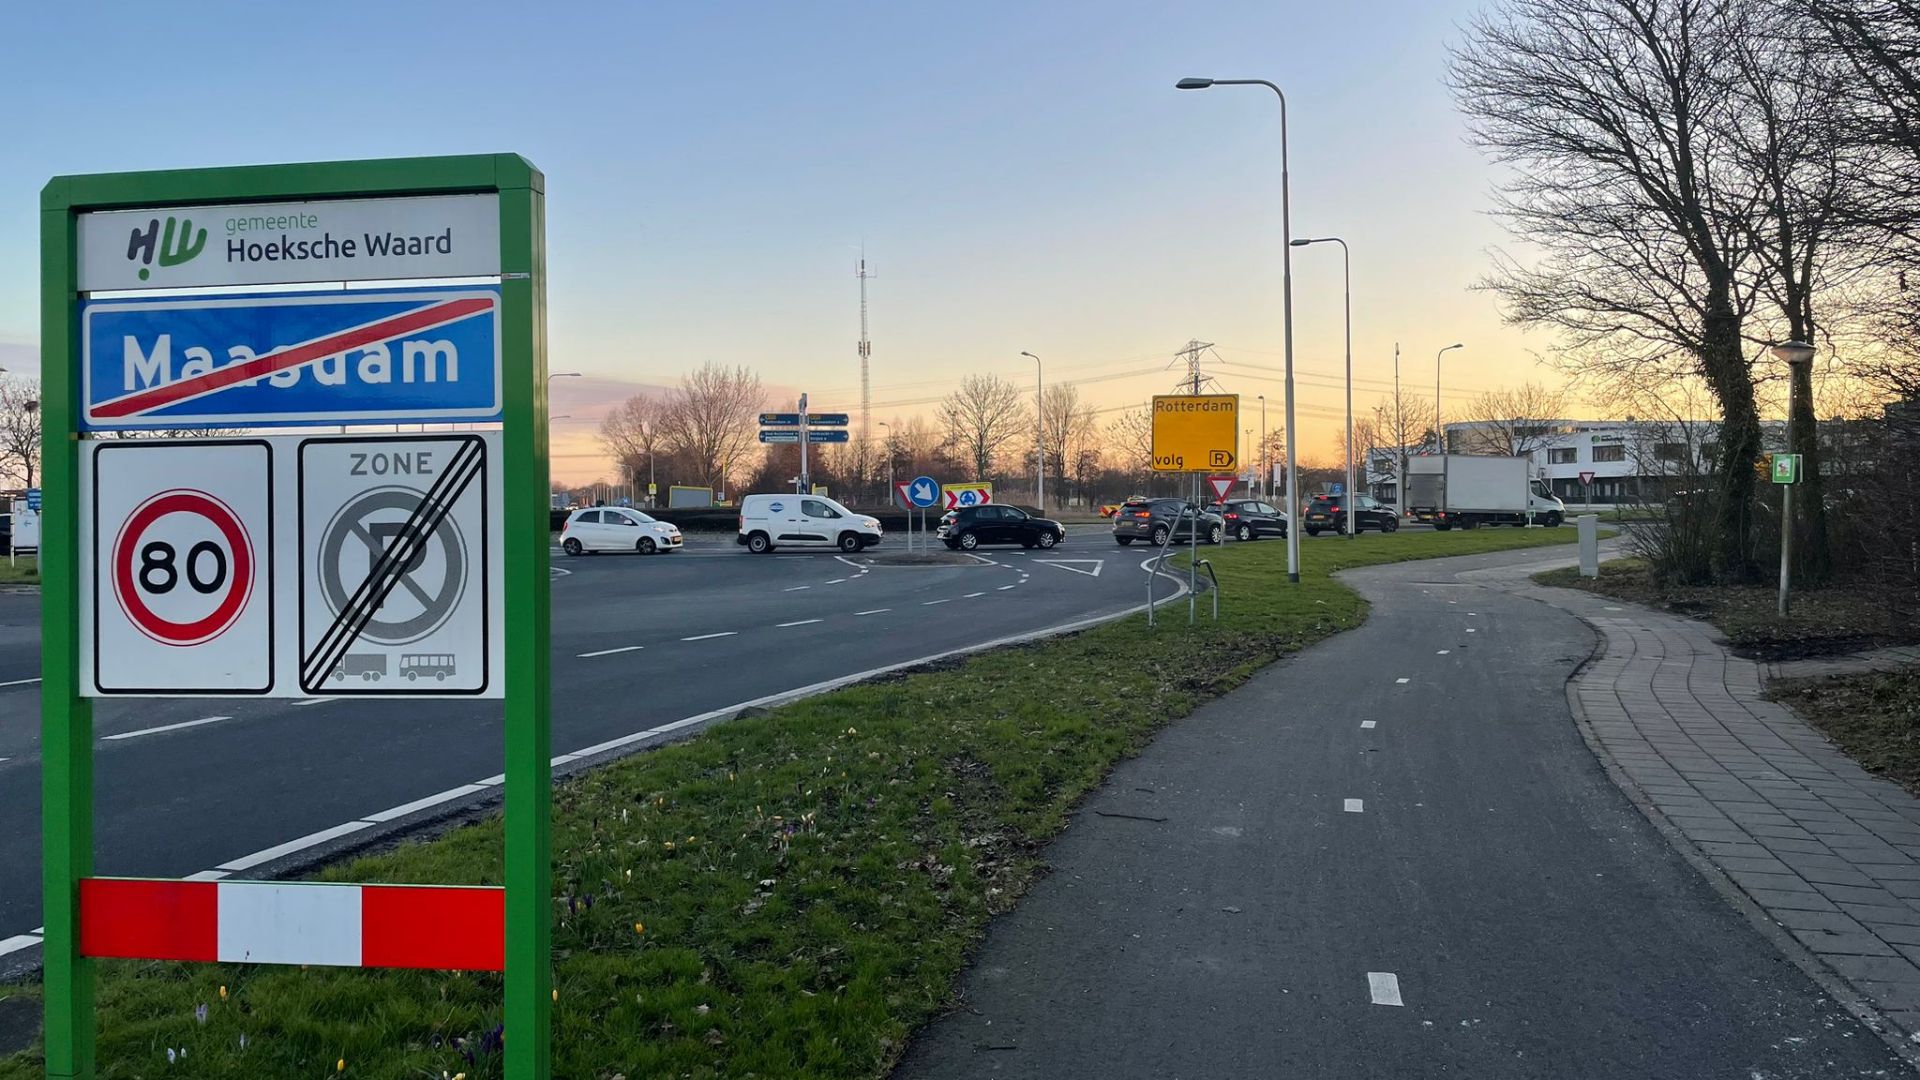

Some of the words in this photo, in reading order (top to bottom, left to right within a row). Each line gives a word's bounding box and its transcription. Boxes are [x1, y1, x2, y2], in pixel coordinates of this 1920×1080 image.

[225, 212, 318, 236] gemeente
[227, 232, 356, 263] Hoeksche
[363, 227, 451, 257] Waard
[1155, 400, 1233, 412] Rotterdam
[349, 452, 433, 476] ZONE
[1155, 453, 1183, 469] volg
[1214, 453, 1225, 465] R
[138, 540, 227, 595] 80
